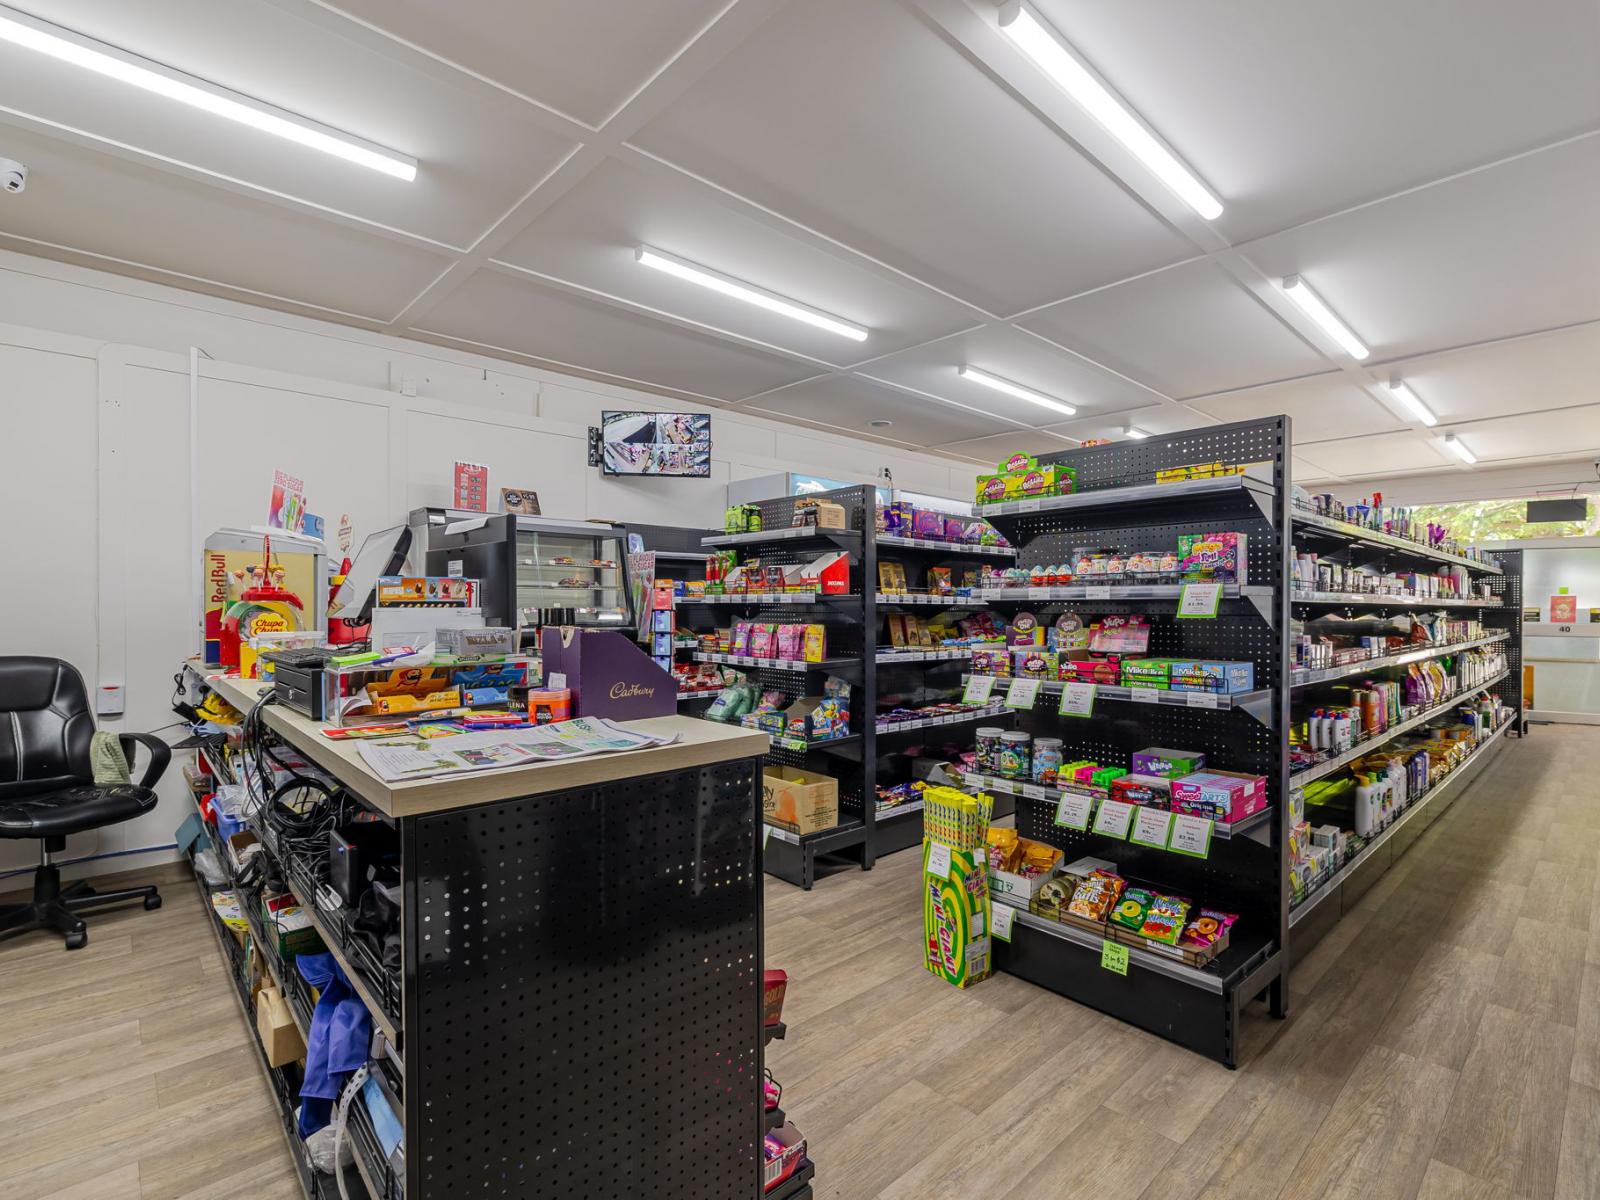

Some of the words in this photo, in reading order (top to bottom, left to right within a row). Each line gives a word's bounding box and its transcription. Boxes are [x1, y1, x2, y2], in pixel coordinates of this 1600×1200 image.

[255, 619, 285, 627] Chupa
[610, 681, 655, 699] Cadbury
[966, 873, 987, 893] GIANT
[929, 883, 946, 921] MINI
[939, 926, 958, 978] GIANT
